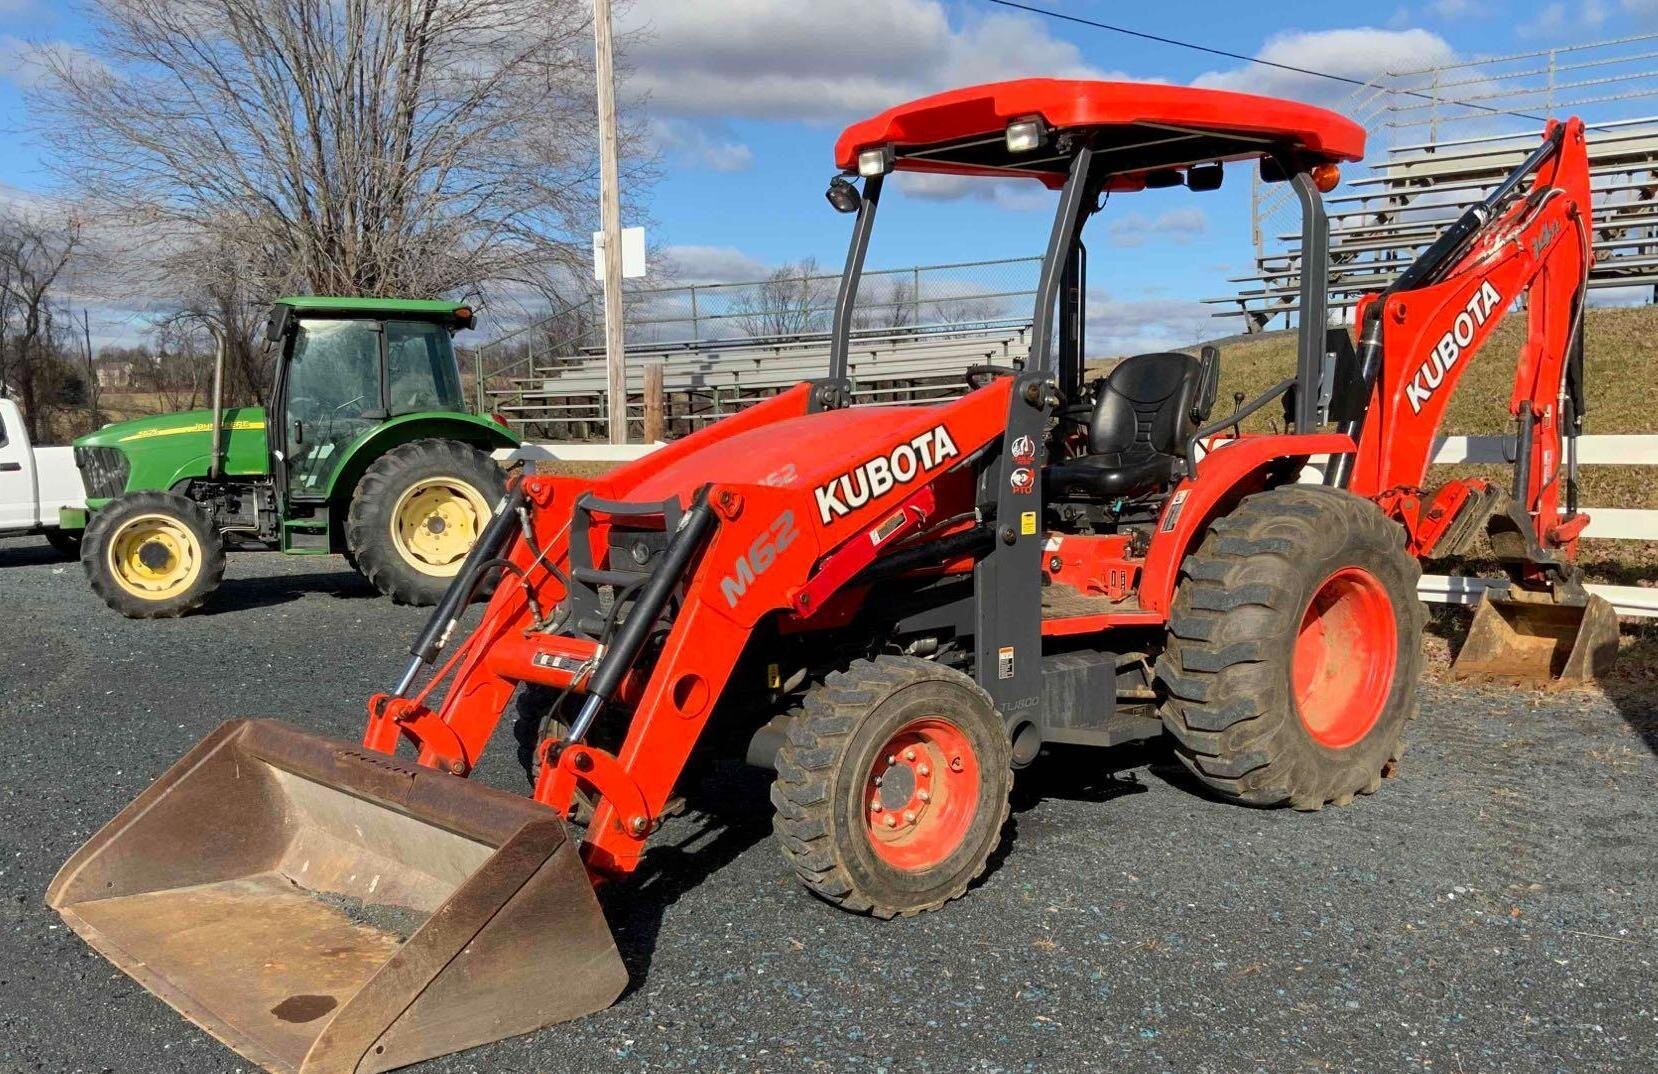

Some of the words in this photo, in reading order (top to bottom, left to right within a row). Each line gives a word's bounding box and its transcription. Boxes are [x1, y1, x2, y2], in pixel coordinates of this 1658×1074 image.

[1405, 279, 1501, 414] KUBOTA
[757, 464, 798, 487] 62
[814, 425, 958, 524] KUBOTA
[1012, 486, 1032, 495] PTO
[719, 509, 799, 608] M62
